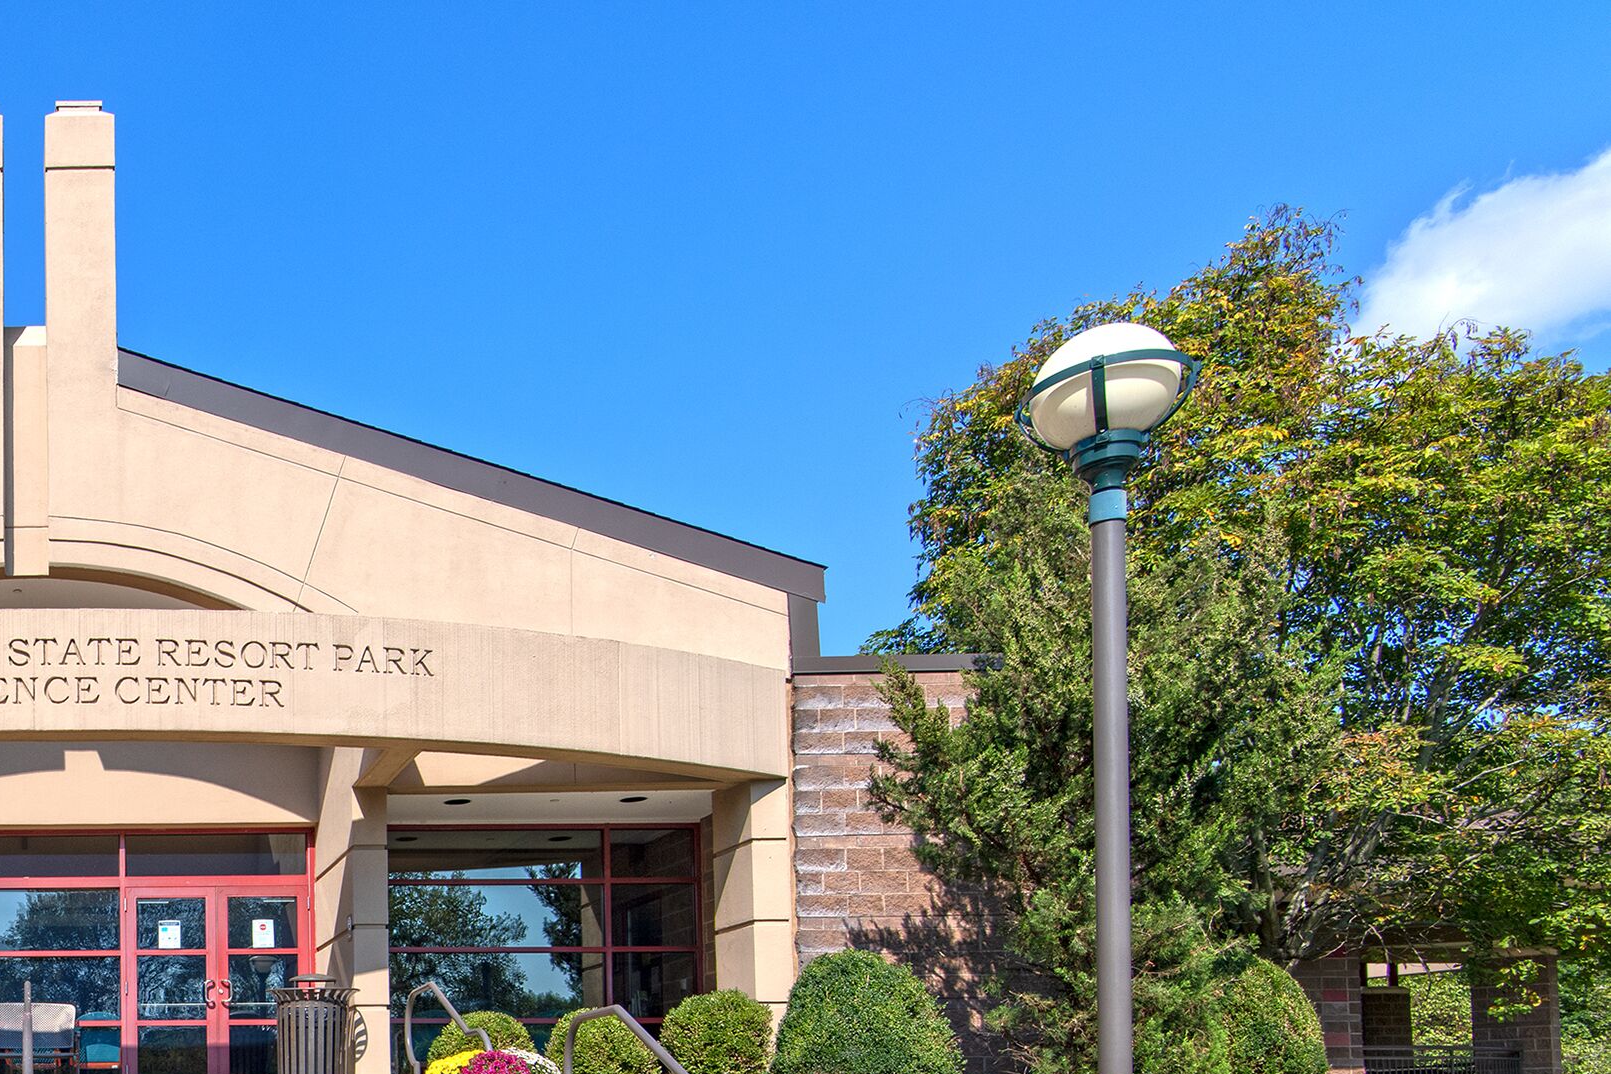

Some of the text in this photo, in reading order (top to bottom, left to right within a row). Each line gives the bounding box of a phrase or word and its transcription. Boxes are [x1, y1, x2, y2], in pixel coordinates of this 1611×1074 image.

[8, 637, 141, 667] STATE
[155, 638, 320, 671] RESORT
[332, 643, 434, 677] PARK
[114, 676, 285, 708] CENTER
